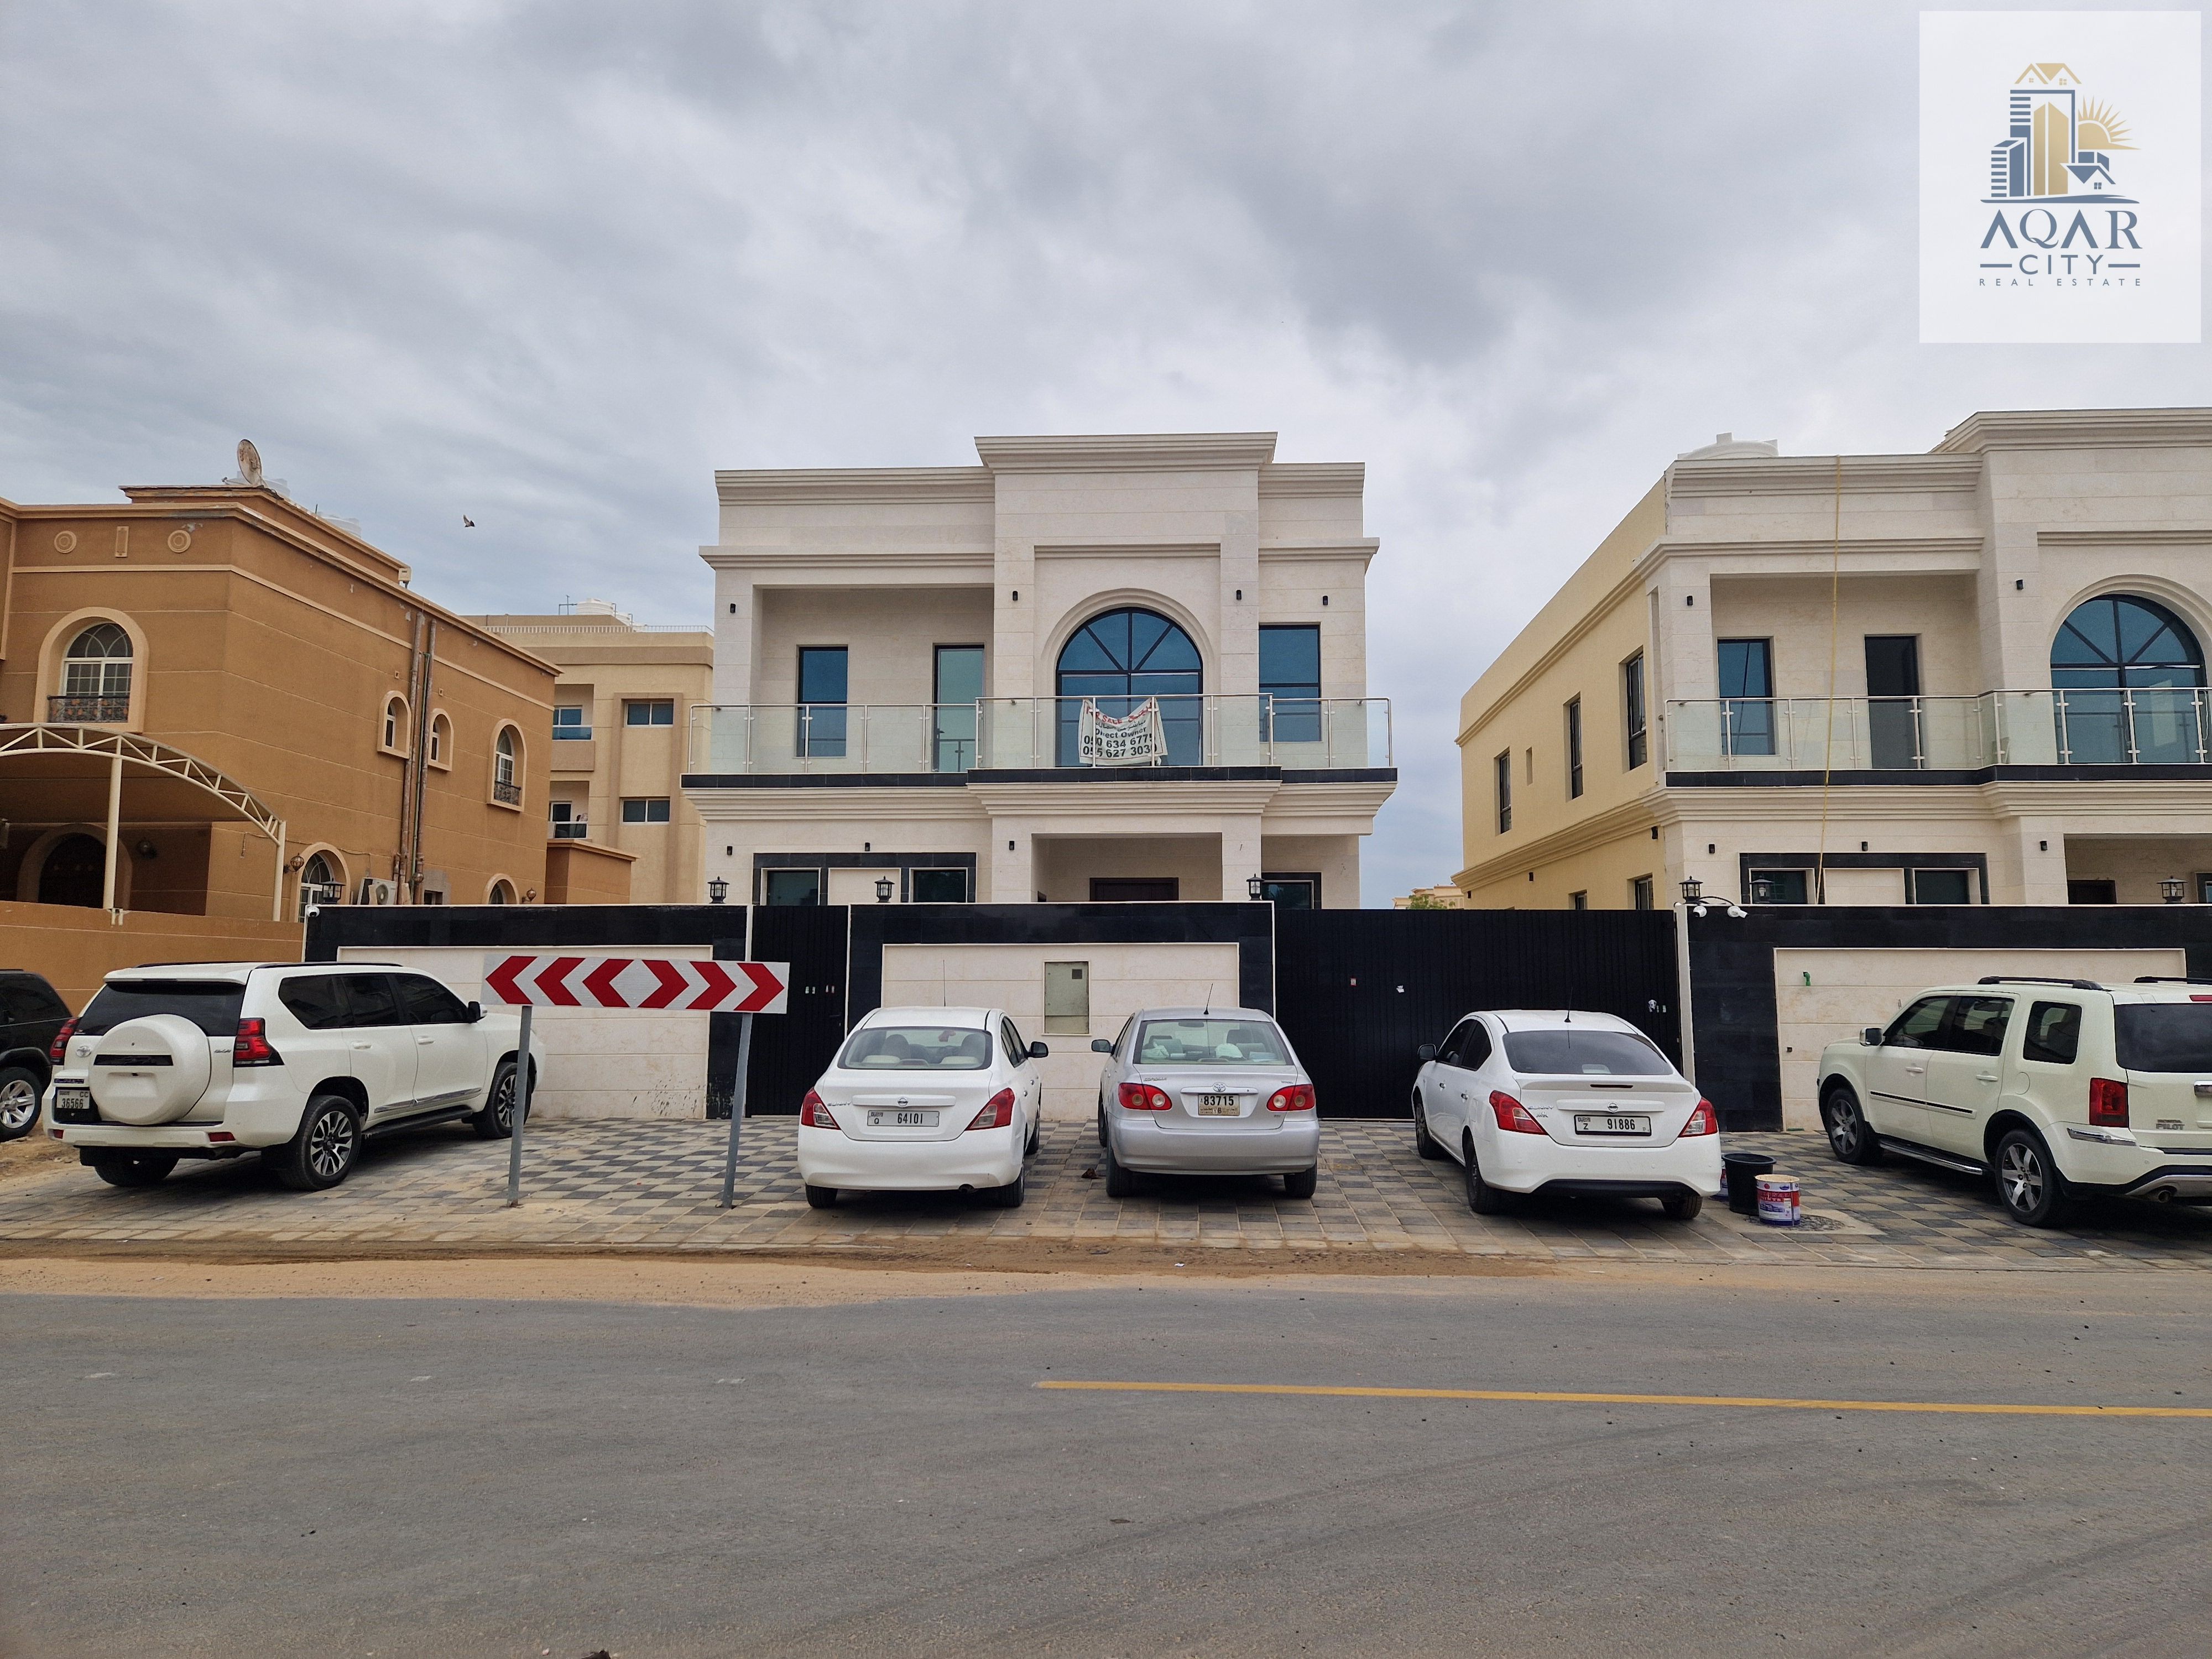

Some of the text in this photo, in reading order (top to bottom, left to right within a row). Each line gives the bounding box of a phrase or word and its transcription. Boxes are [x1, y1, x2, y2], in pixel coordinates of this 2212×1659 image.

[1086, 706, 1123, 725] FR SALE
[1121, 727, 1146, 738] Owner
[1106, 740, 1126, 749] 634
[1105, 748, 1126, 758] 627
[61, 1098, 84, 1109] 36566
[1203, 1095, 1234, 1106] 83715
[897, 1113, 923, 1124] 64101
[1607, 1118, 1636, 1130] 91886
